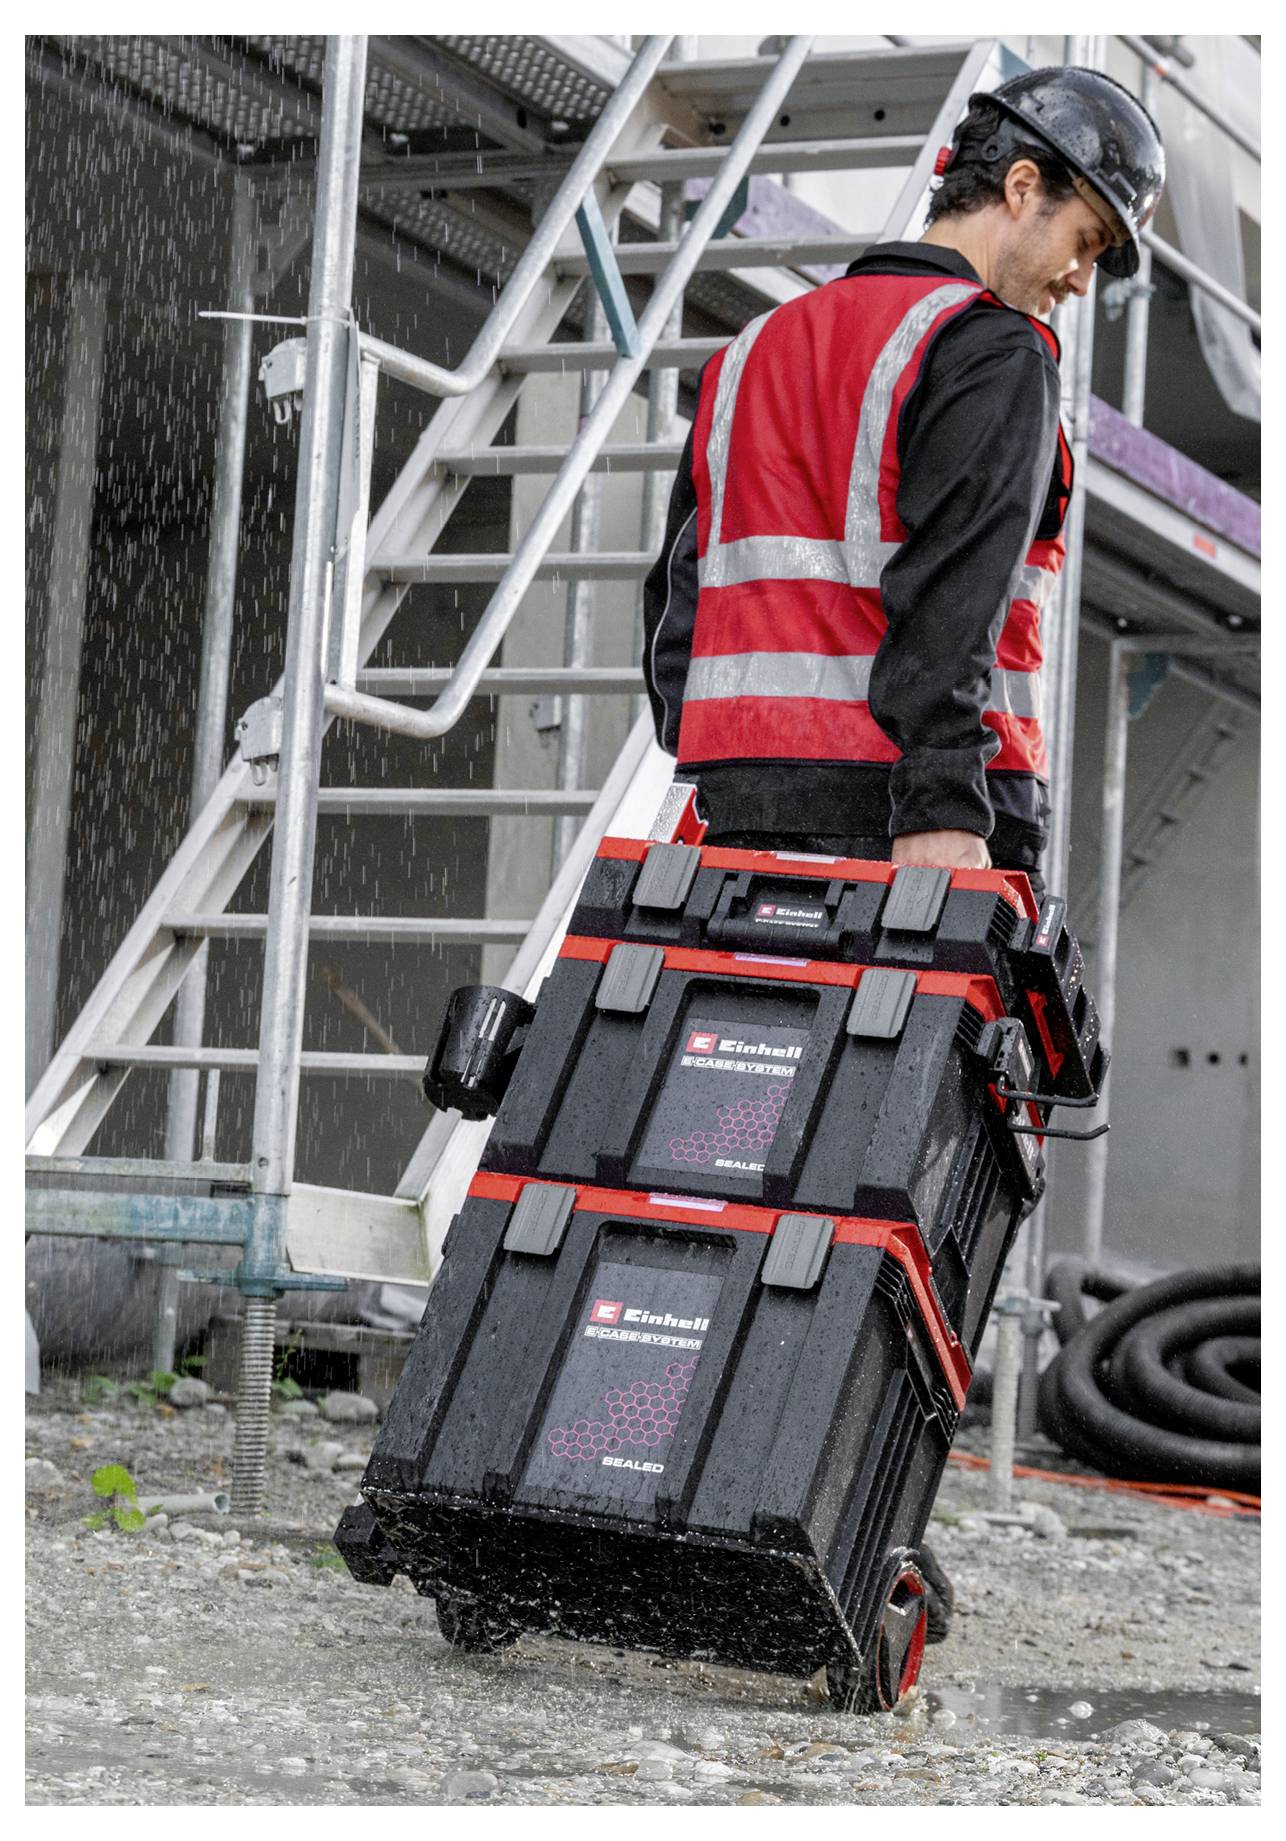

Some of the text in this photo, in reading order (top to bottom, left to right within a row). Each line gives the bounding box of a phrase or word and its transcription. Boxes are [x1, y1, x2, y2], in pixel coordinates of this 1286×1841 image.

[775, 908, 823, 919] Einhell
[718, 1039, 803, 1059] Einhell
[623, 1308, 710, 1331] Einhell
[602, 1456, 665, 1473] SEALED
